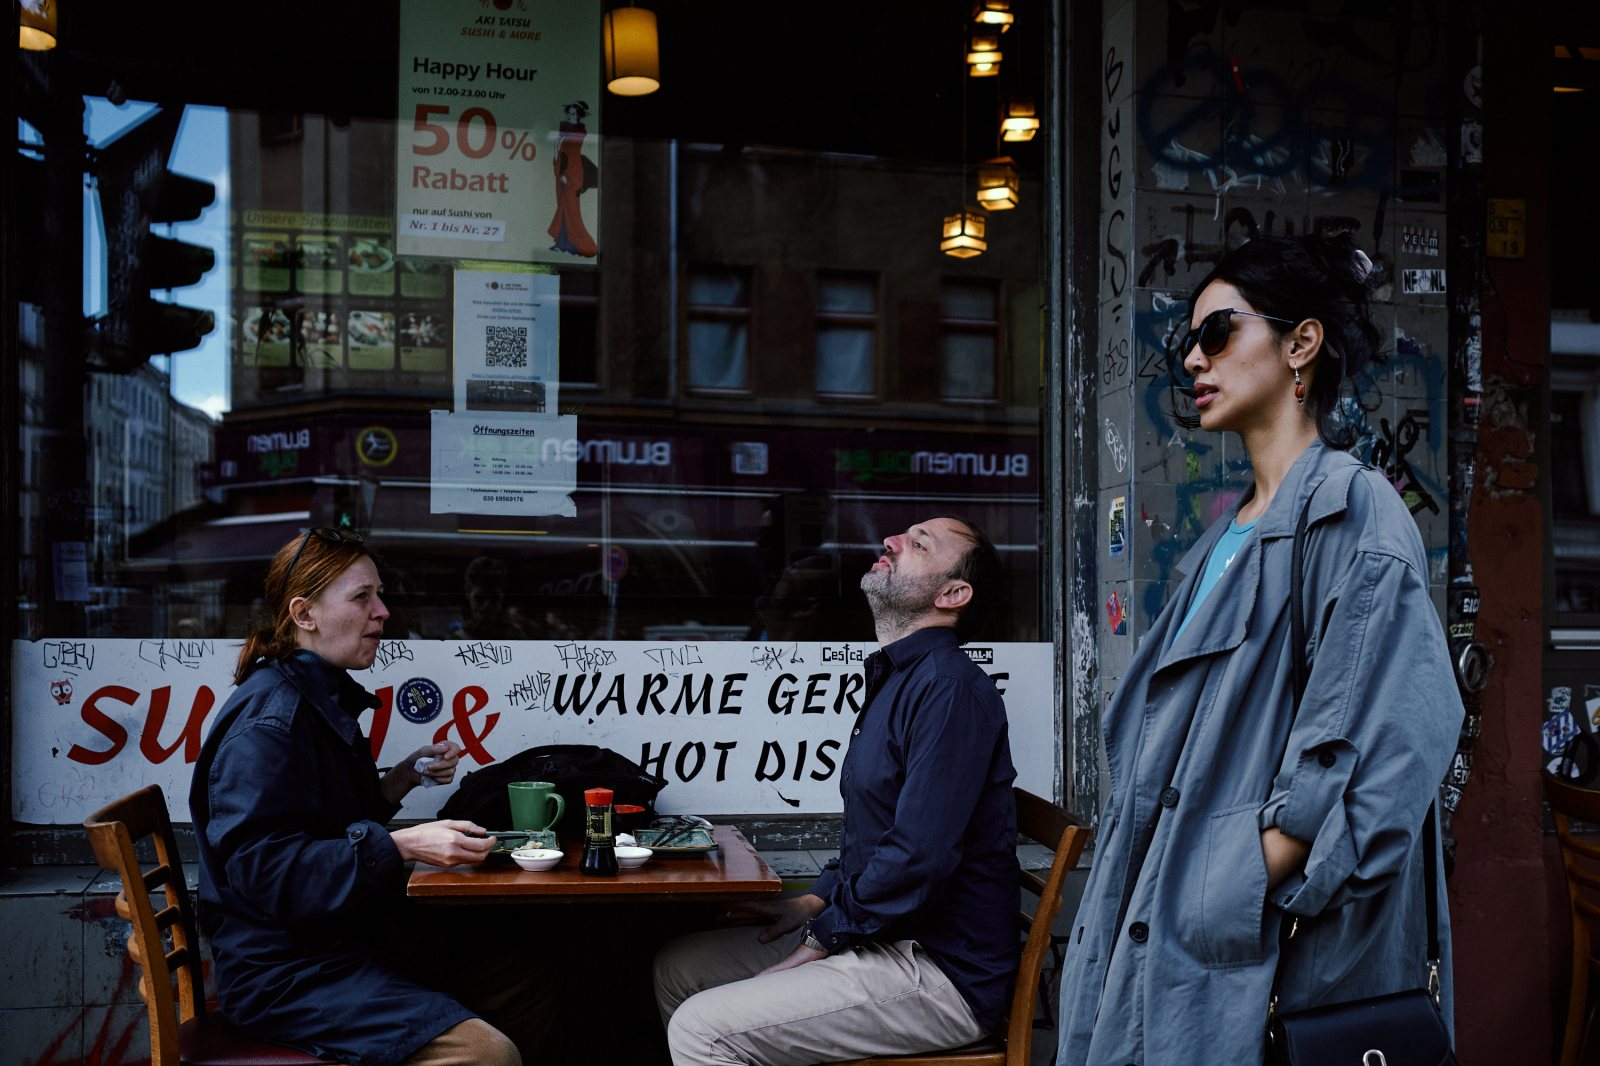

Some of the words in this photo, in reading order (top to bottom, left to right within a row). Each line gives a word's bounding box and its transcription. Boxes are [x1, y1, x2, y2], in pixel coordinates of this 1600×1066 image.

[475, 15, 496, 25] AKI
[498, 17, 531, 28] TATSU
[460, 27, 496, 38] SUSHI
[498, 30, 506, 39] &
[509, 31, 542, 41] MORE
[413, 57, 480, 81] Happy
[486, 62, 538, 82] Hour
[412, 87, 430, 95] von
[433, 86, 486, 98] 12.00-23.00
[489, 91, 506, 100] Uhr
[412, 165, 509, 194] Rabatt
[412, 209, 429, 218] nur
[431, 208, 446, 217] auf
[448, 208, 473, 219] Sushi
[474, 211, 493, 219] von
[409, 220, 427, 231] Nr.
[431, 222, 438, 232] 1
[442, 223, 459, 233] bis
[462, 225, 480, 235] Nr.
[482, 227, 500, 237] 27
[473, 424, 535, 437] Öffnungszeiten
[553, 672, 749, 716] WARME
[433, 685, 501, 766] &
[640, 741, 738, 782] HOT
